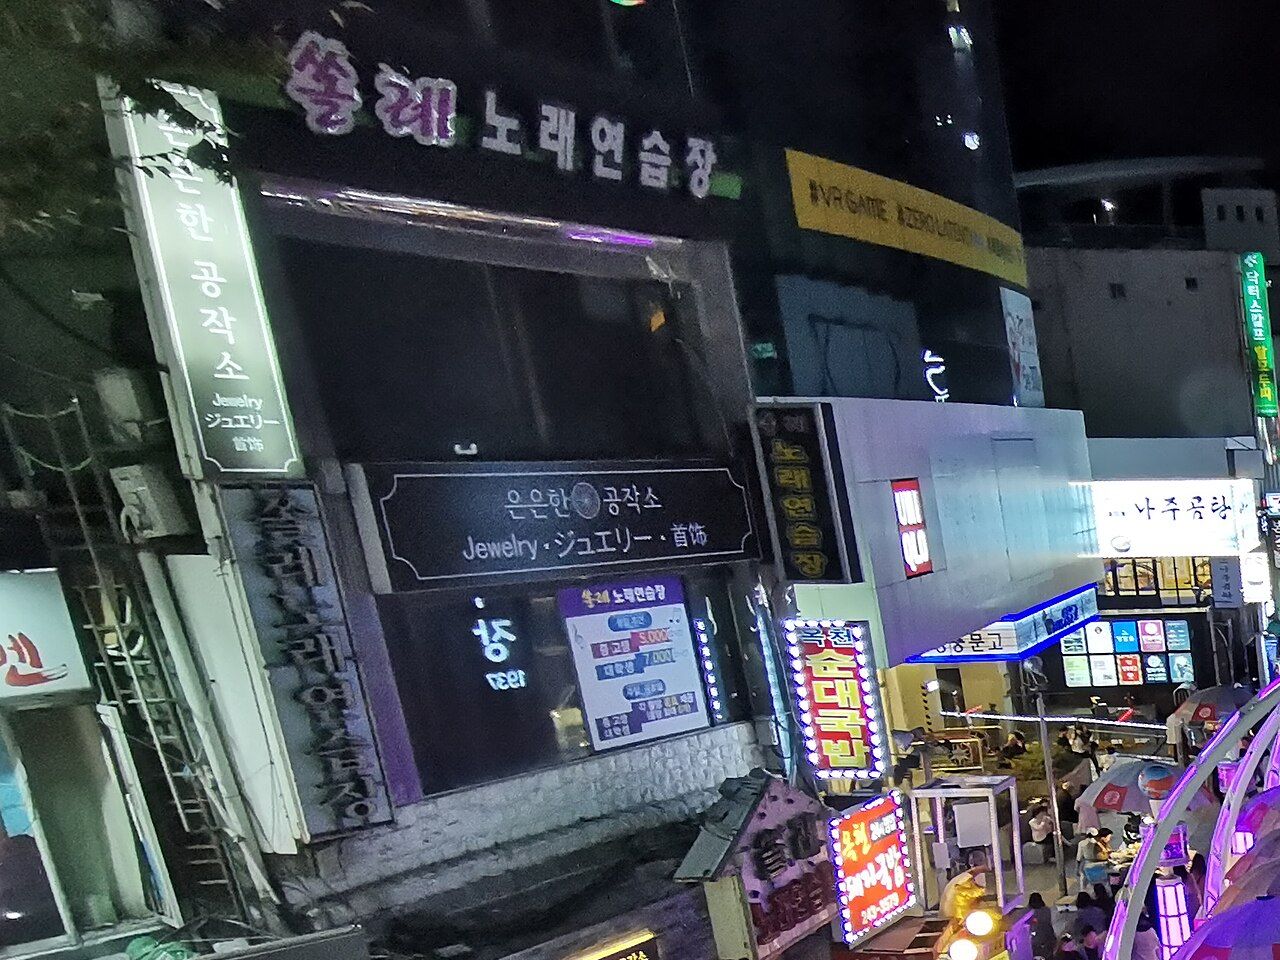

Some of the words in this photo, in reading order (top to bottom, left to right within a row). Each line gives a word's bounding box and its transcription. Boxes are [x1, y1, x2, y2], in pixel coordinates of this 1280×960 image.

[481, 90, 718, 199] 노래연습장
[190, 259, 250, 381] 공작소
[211, 391, 264, 411] Jewelry
[204, 411, 281, 430] ジュエリー
[504, 487, 570, 520] 은은한
[602, 484, 663, 516] 공작소
[1134, 495, 1232, 521] 나주곰탕
[462, 532, 538, 562] Jewelry
[555, 529, 653, 559] ジュエリー
